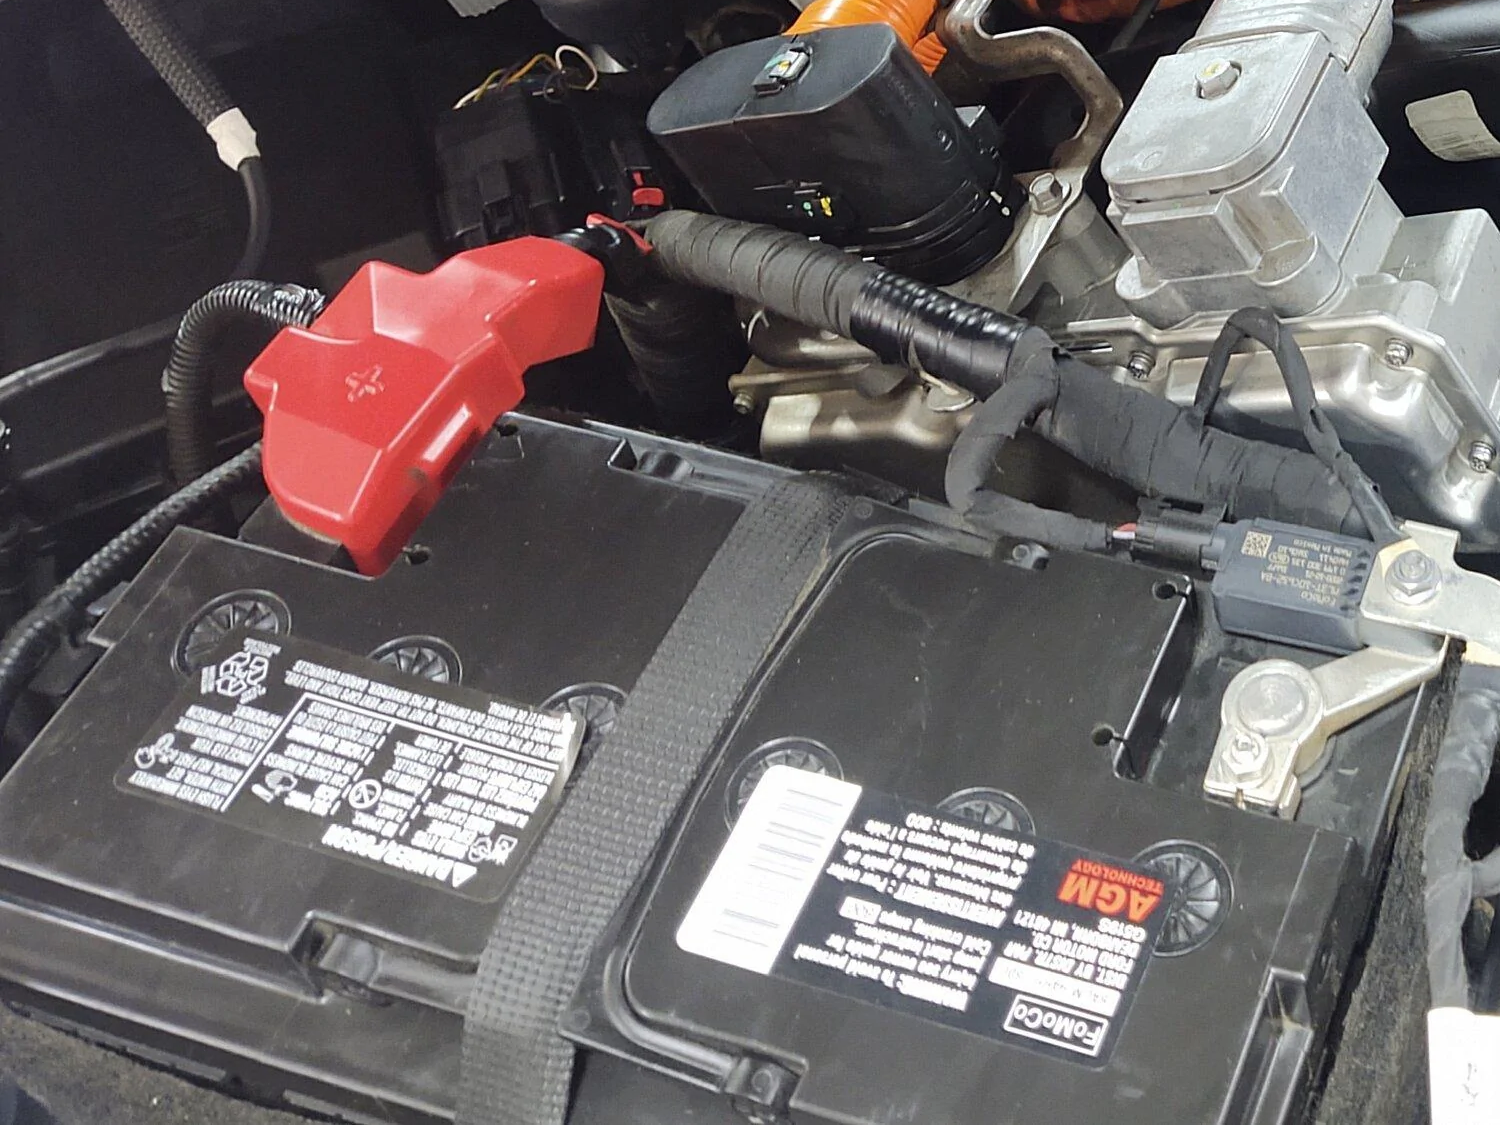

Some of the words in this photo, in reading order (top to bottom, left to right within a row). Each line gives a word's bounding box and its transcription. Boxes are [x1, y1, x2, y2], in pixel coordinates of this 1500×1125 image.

[1070, 856, 1165, 895] TECHNOLOGY
[1056, 869, 1158, 925] AGM
[1050, 937, 1099, 963] MOTOR
[1096, 950, 1134, 973] FORD
[1009, 1002, 1102, 1046] FoMoCo
